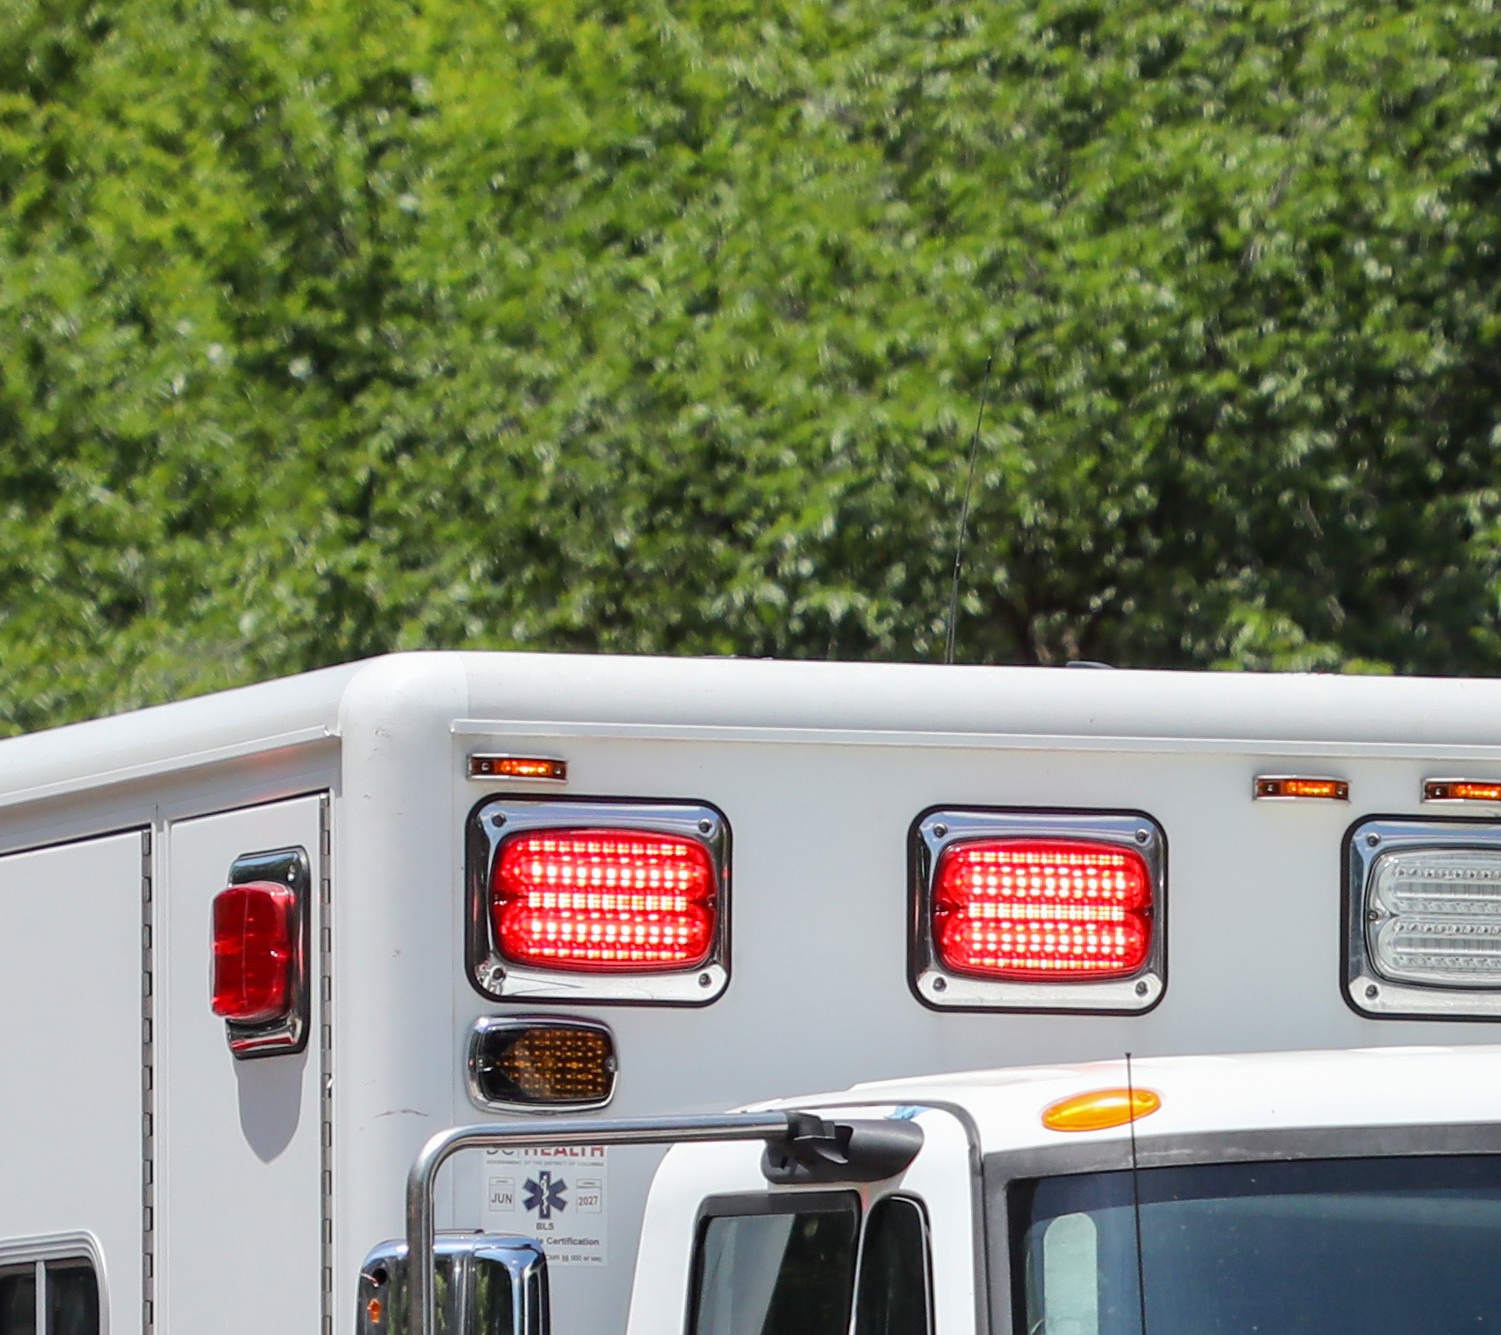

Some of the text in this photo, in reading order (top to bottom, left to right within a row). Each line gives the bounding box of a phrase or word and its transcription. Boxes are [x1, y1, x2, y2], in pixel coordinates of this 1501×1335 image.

[491, 1193, 513, 1204] JUN
[578, 1196, 598, 1206] 2027
[536, 1222, 554, 1230] BLS
[546, 1237, 600, 1246] Certification
